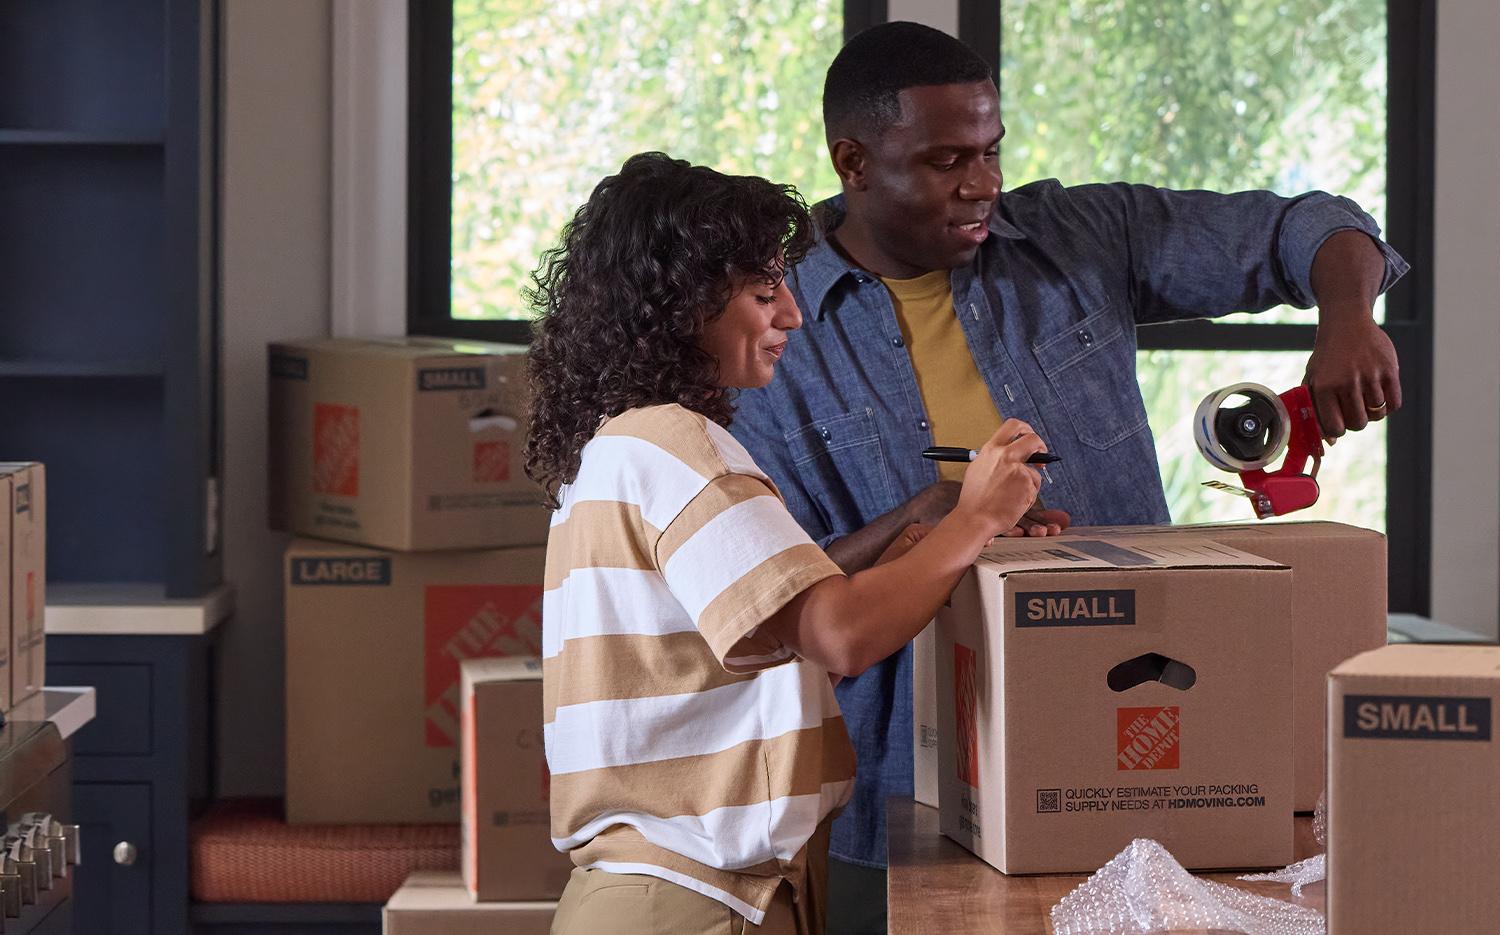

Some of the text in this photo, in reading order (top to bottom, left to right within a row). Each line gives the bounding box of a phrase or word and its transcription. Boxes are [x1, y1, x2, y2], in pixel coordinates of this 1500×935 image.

[421, 370, 482, 388] SMALL
[299, 559, 382, 581] LARGE
[1026, 596, 1125, 621] SMALL
[1122, 713, 1150, 738] THE
[1357, 702, 1479, 733] SMALL
[1117, 706, 1180, 769] HOME
[1141, 728, 1180, 769] DEPOT
[1065, 784, 1259, 800] QUICKLY ESTIMATE YOUR PACKING
[1065, 797, 1266, 812] SUPPLY NEEDS AT HDMOVING.COM
